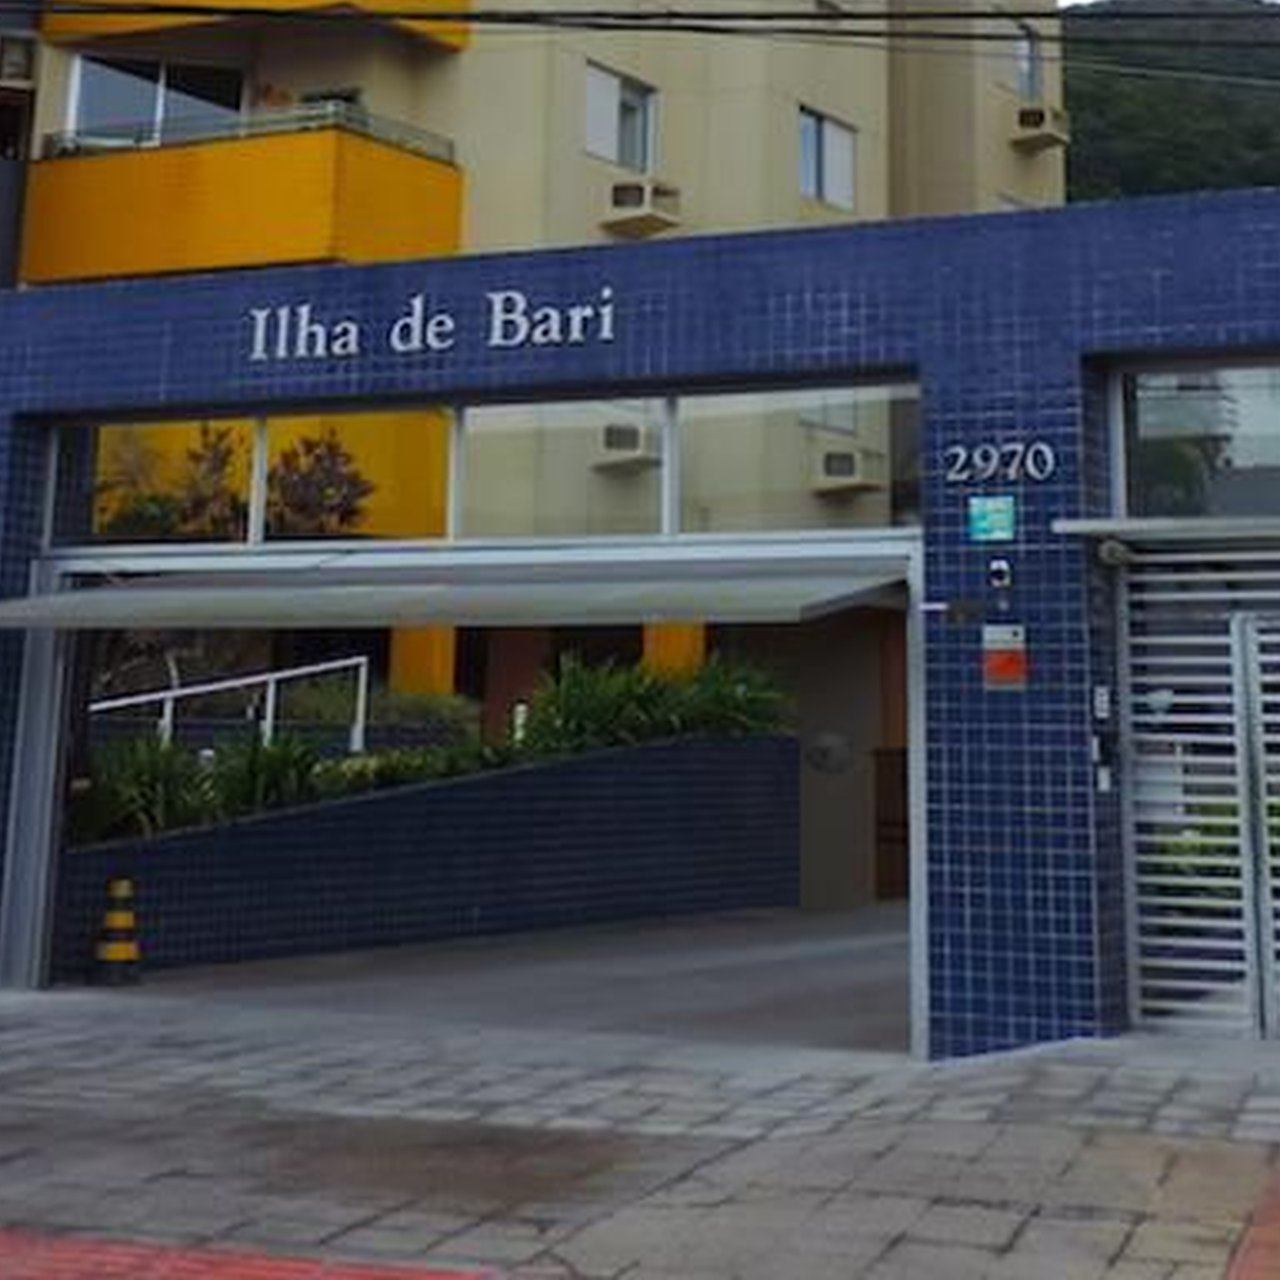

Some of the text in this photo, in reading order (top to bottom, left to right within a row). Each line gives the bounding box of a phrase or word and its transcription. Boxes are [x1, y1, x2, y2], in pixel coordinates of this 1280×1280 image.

[248, 286, 615, 361] Ilha de Bari
[944, 440, 1055, 481] 2970
